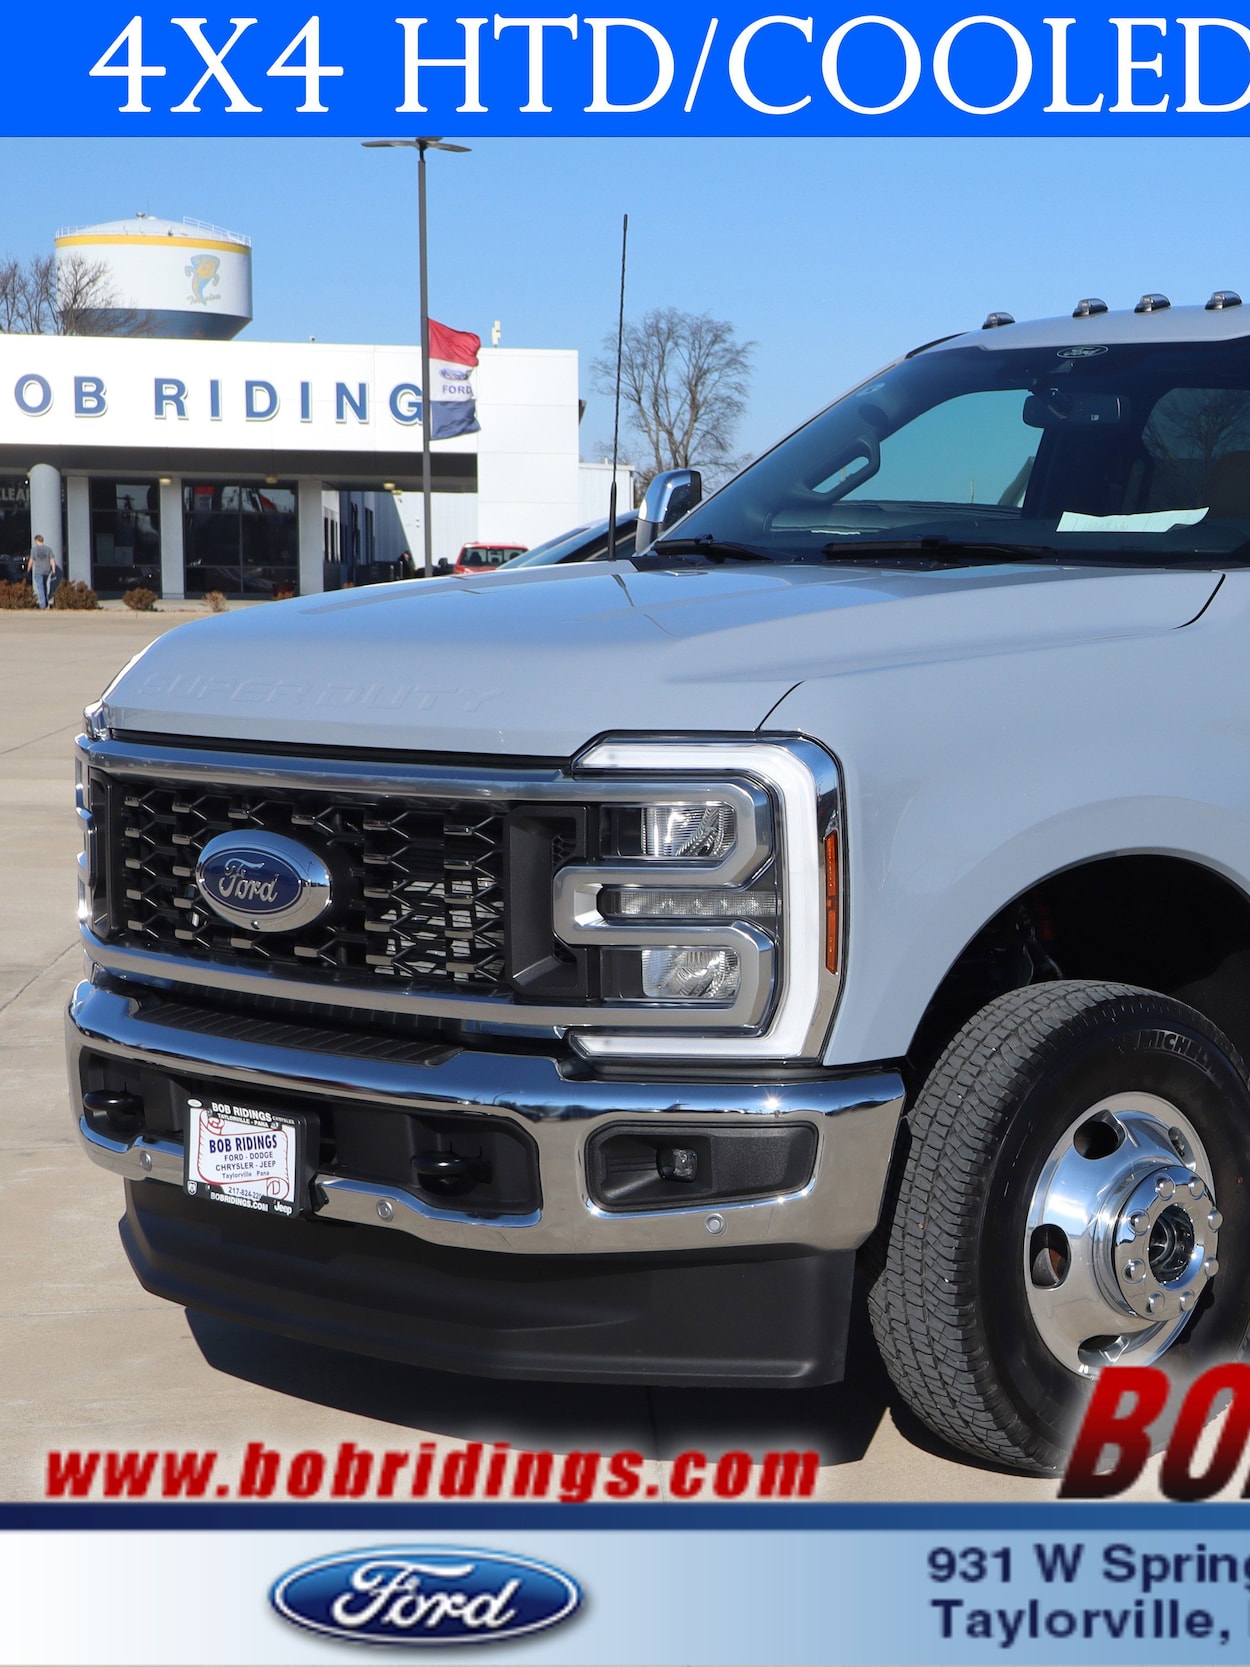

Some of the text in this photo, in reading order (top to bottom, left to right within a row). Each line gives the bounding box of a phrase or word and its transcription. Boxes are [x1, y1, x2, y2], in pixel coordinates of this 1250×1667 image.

[442, 385, 472, 395] FORD
[137, 673, 504, 713] SUPER DUTY
[218, 857, 280, 903] Ford
[211, 1102, 232, 1115] BOB
[232, 1106, 273, 1122] RIDINGS
[209, 1134, 278, 1153] BOB RIDINGS
[215, 1161, 254, 1172] CHRYSLER
[259, 1160, 276, 1169] JEEP
[224, 1153, 244, 1162] FORD
[249, 1151, 274, 1160] DODGE
[222, 1171, 252, 1181] Taylorville
[210, 1192, 292, 1216] BOBRIDINGS.COM Jeep
